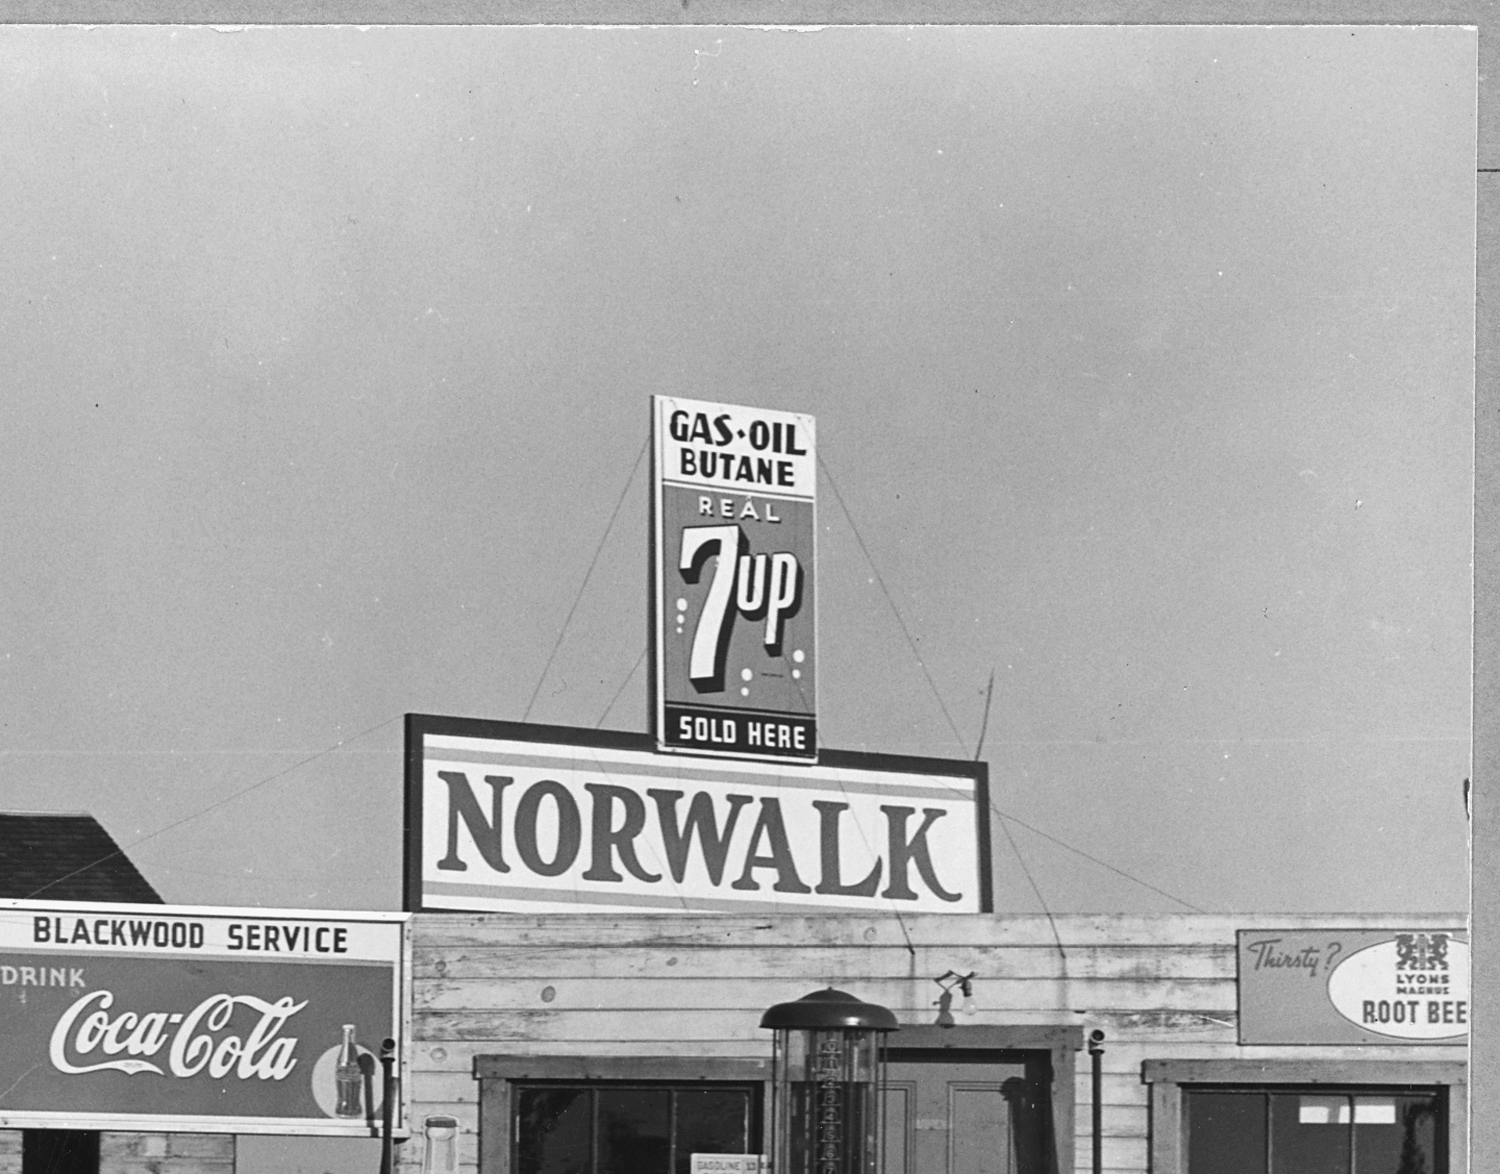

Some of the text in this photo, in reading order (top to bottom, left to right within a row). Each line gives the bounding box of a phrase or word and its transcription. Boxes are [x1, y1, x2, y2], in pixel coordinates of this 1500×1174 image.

[680, 448, 795, 488] BUTANE
[698, 495, 781, 523] REAL
[679, 716, 806, 750] SOLD HERE
[437, 770, 963, 902] NORWALK
[33, 916, 349, 953] BLACKWOOD SERVICE
[0, 965, 86, 989] DRINK
[1396, 974, 1450, 984] LYONS
[1362, 1000, 1420, 1025] ROOT
[49, 990, 309, 1081] Coca-Cola
